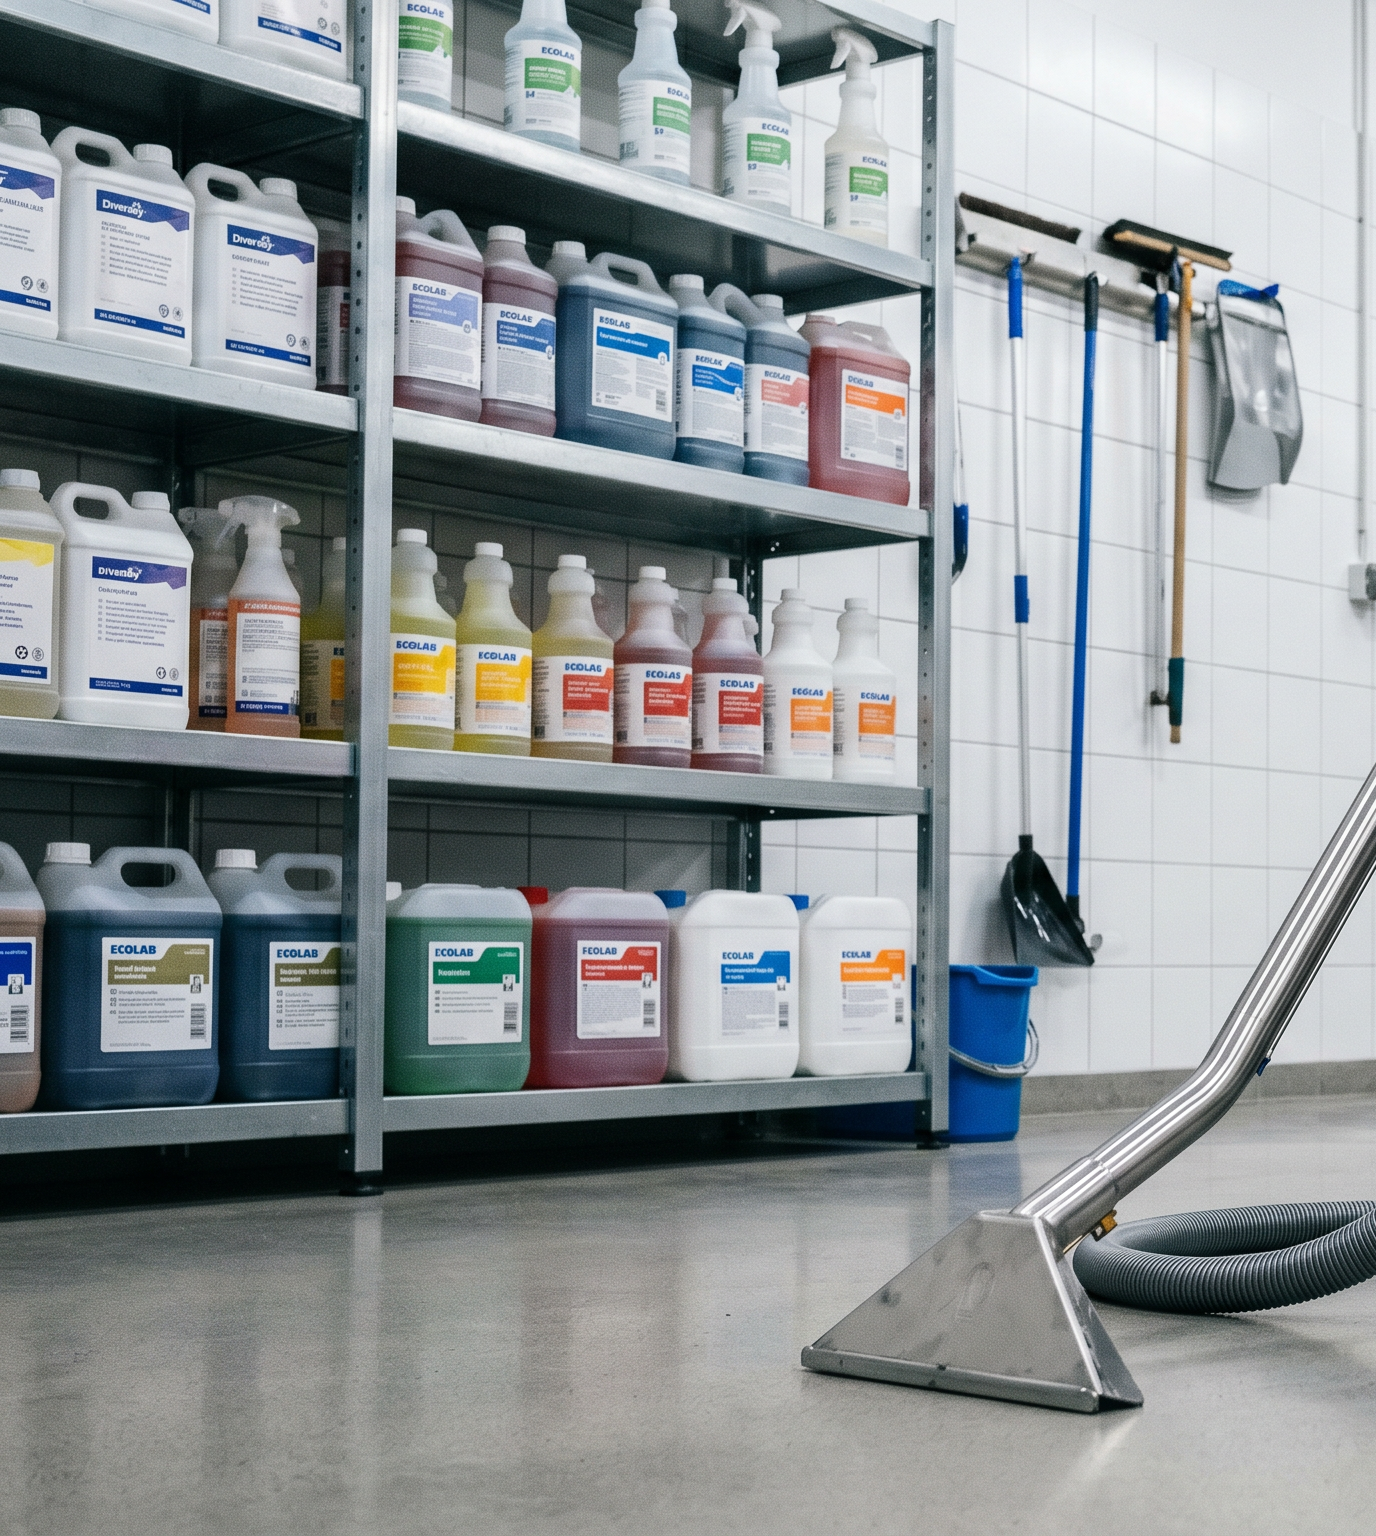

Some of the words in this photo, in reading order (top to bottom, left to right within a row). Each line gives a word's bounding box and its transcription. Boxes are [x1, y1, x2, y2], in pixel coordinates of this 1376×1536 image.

[110, 944, 157, 956] ECOLAB
[276, 948, 319, 959] ECOLAB
[434, 948, 474, 957] ECOLAB
